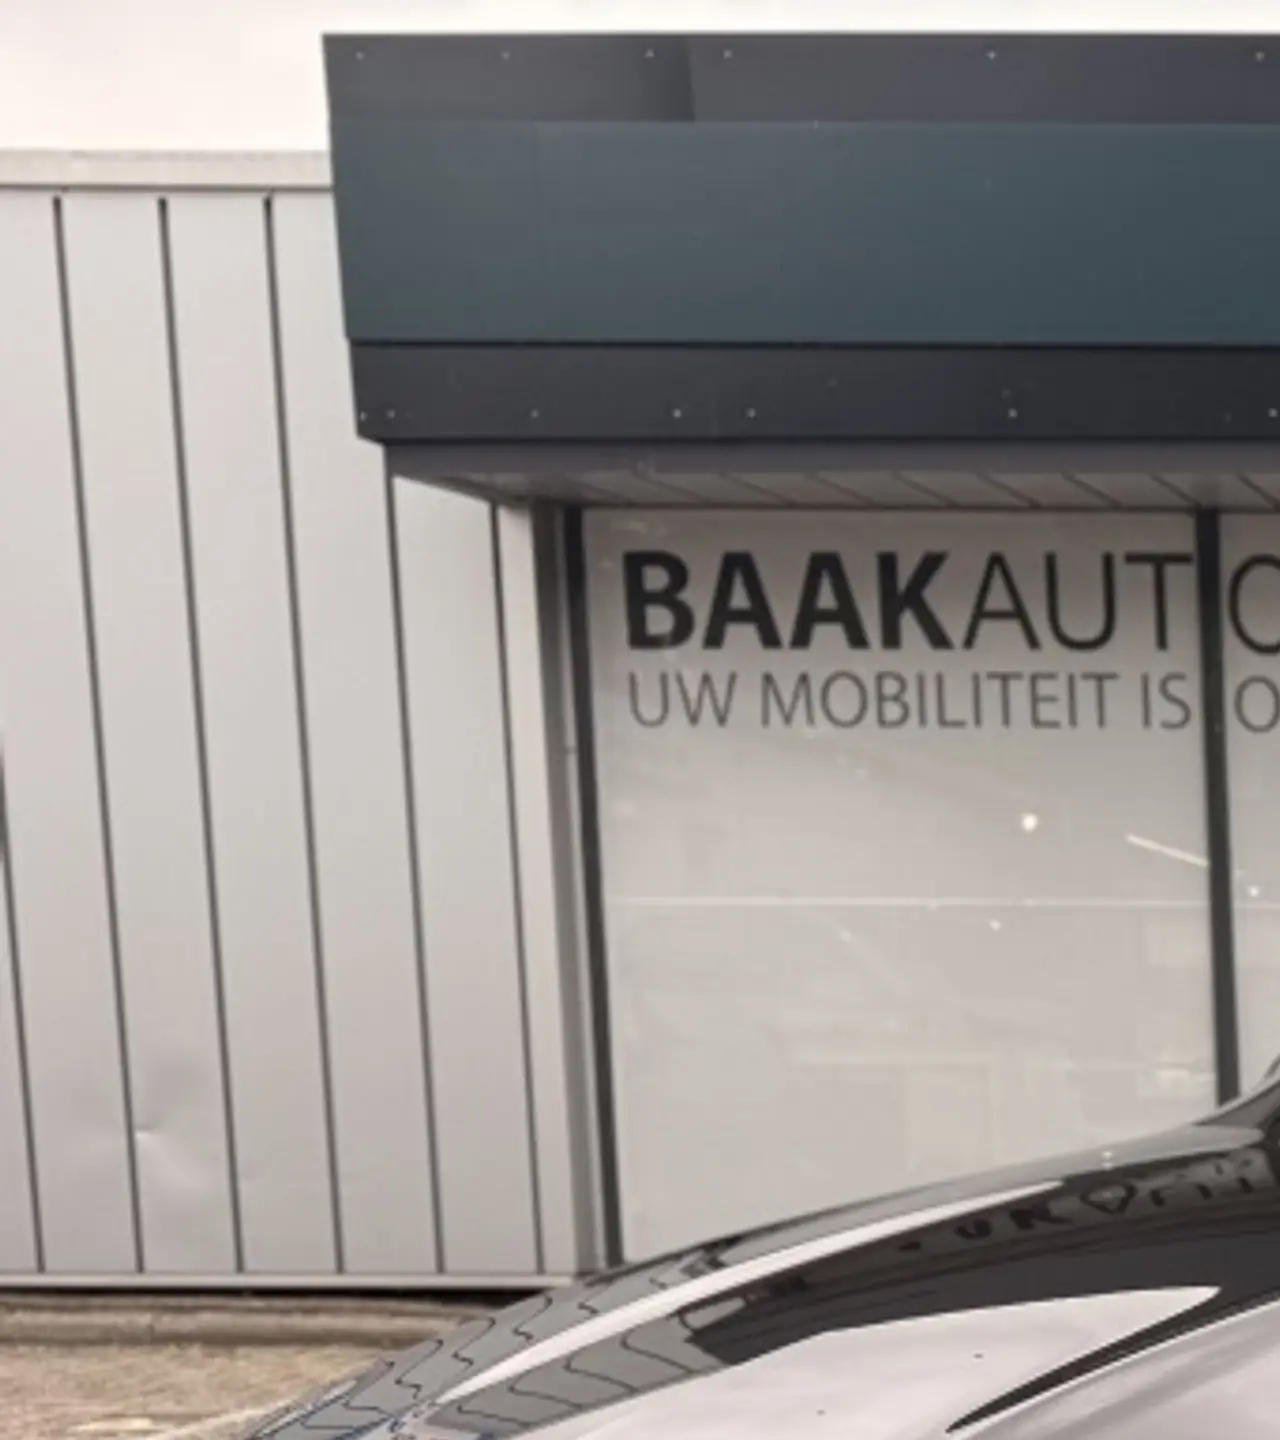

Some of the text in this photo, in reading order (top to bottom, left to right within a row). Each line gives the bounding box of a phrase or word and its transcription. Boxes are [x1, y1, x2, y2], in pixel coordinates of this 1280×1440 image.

[628, 671, 738, 727] UW
[760, 671, 1121, 729] MOBILITEIT
[1142, 672, 1193, 729] IS
